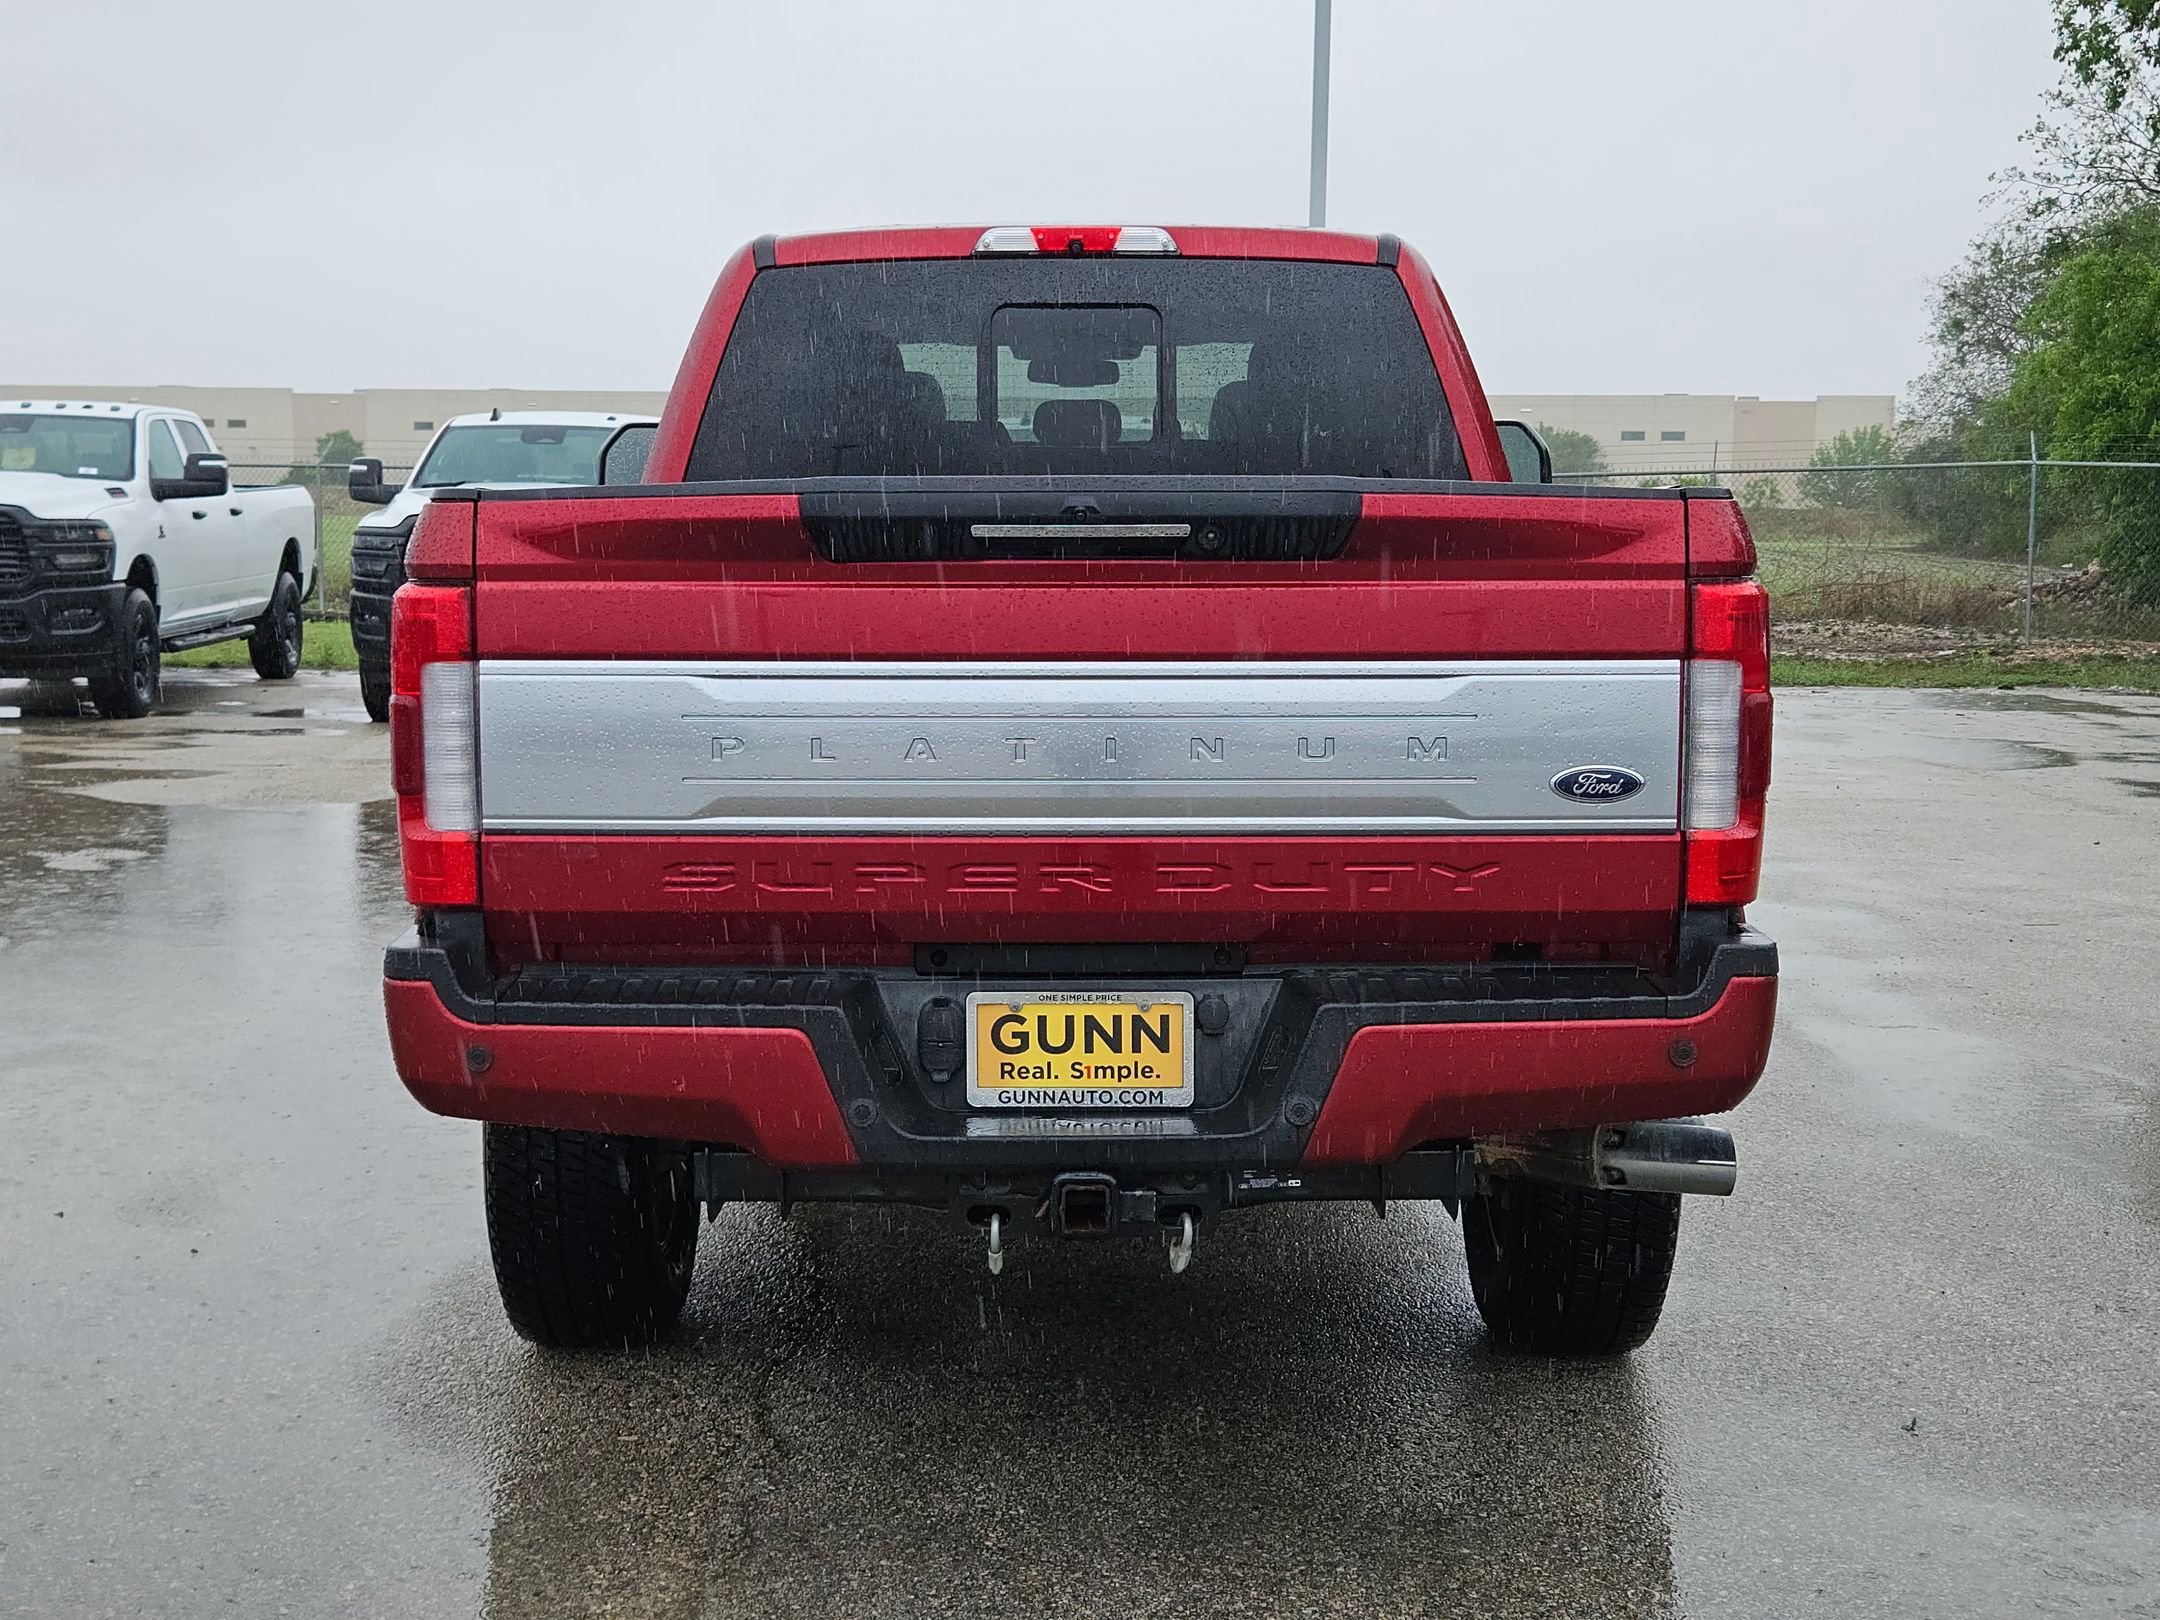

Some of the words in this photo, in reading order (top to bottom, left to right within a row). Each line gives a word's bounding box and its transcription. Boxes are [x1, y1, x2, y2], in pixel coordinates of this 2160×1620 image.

[711, 736, 1448, 762] PLATINUM
[1573, 773, 1624, 795] Ford
[662, 862, 1113, 893] SUPER
[1156, 862, 1500, 893] DUTY
[1038, 994, 1058, 1002] ONE
[1060, 994, 1092, 1002] SIMPLE
[1095, 994, 1122, 1002] PRICE
[990, 1014, 1170, 1055] GUNN
[1000, 1061, 1059, 1080] Real.
[998, 1089, 1164, 1105] GUNNAUTO.COM
